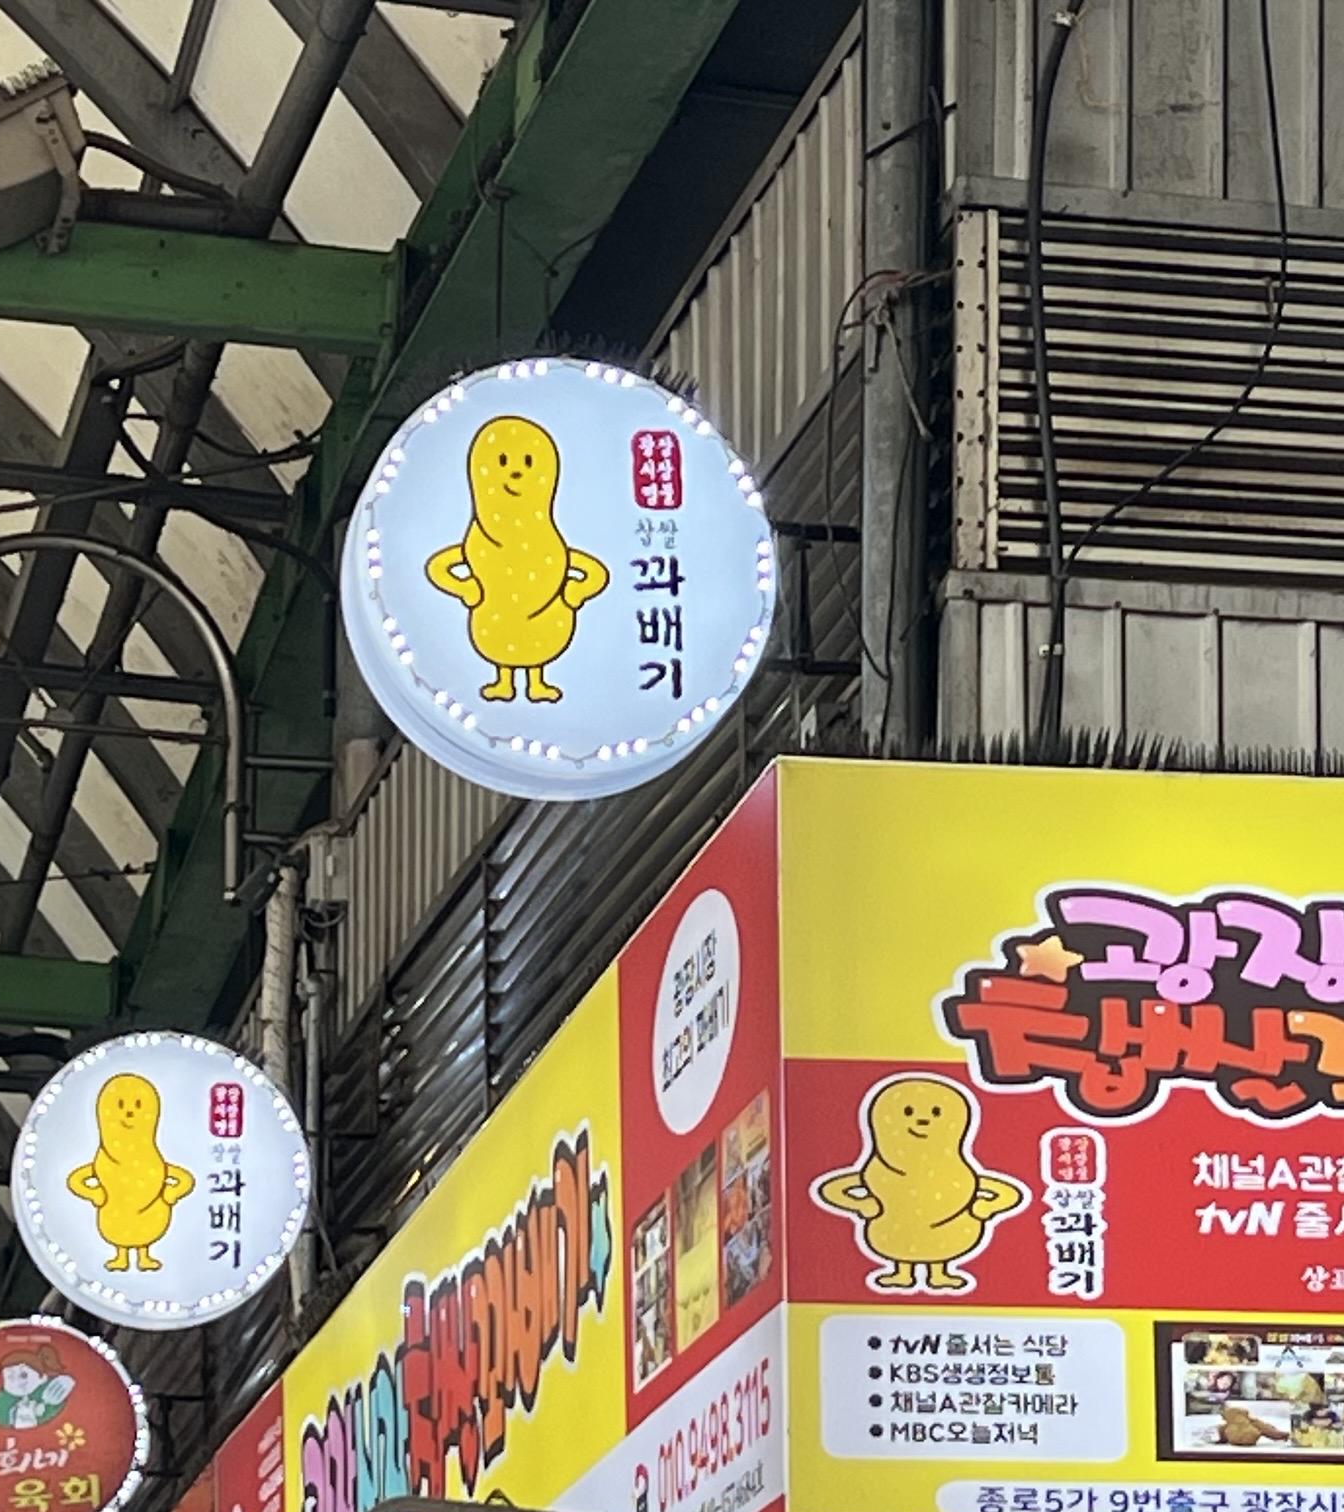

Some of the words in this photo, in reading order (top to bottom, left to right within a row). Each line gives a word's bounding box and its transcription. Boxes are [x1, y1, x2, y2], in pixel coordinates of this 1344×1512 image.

[634, 518, 680, 549] 찹쌀
[630, 555, 686, 700] 꽈배기
[207, 1171, 246, 1270] 꽈배기
[1195, 1201, 1286, 1237] tvN
[1050, 1212, 1098, 1294] 꽈배기
[889, 1333, 942, 1356] tvN
[945, 1333, 1016, 1357] 줄서는
[1022, 1333, 1069, 1358] 식당
[889, 1389, 1079, 1417] 채널A관찰카메라
[889, 1421, 1040, 1446] MBC오늘저녁
[8, 1473, 102, 1512] 육회
